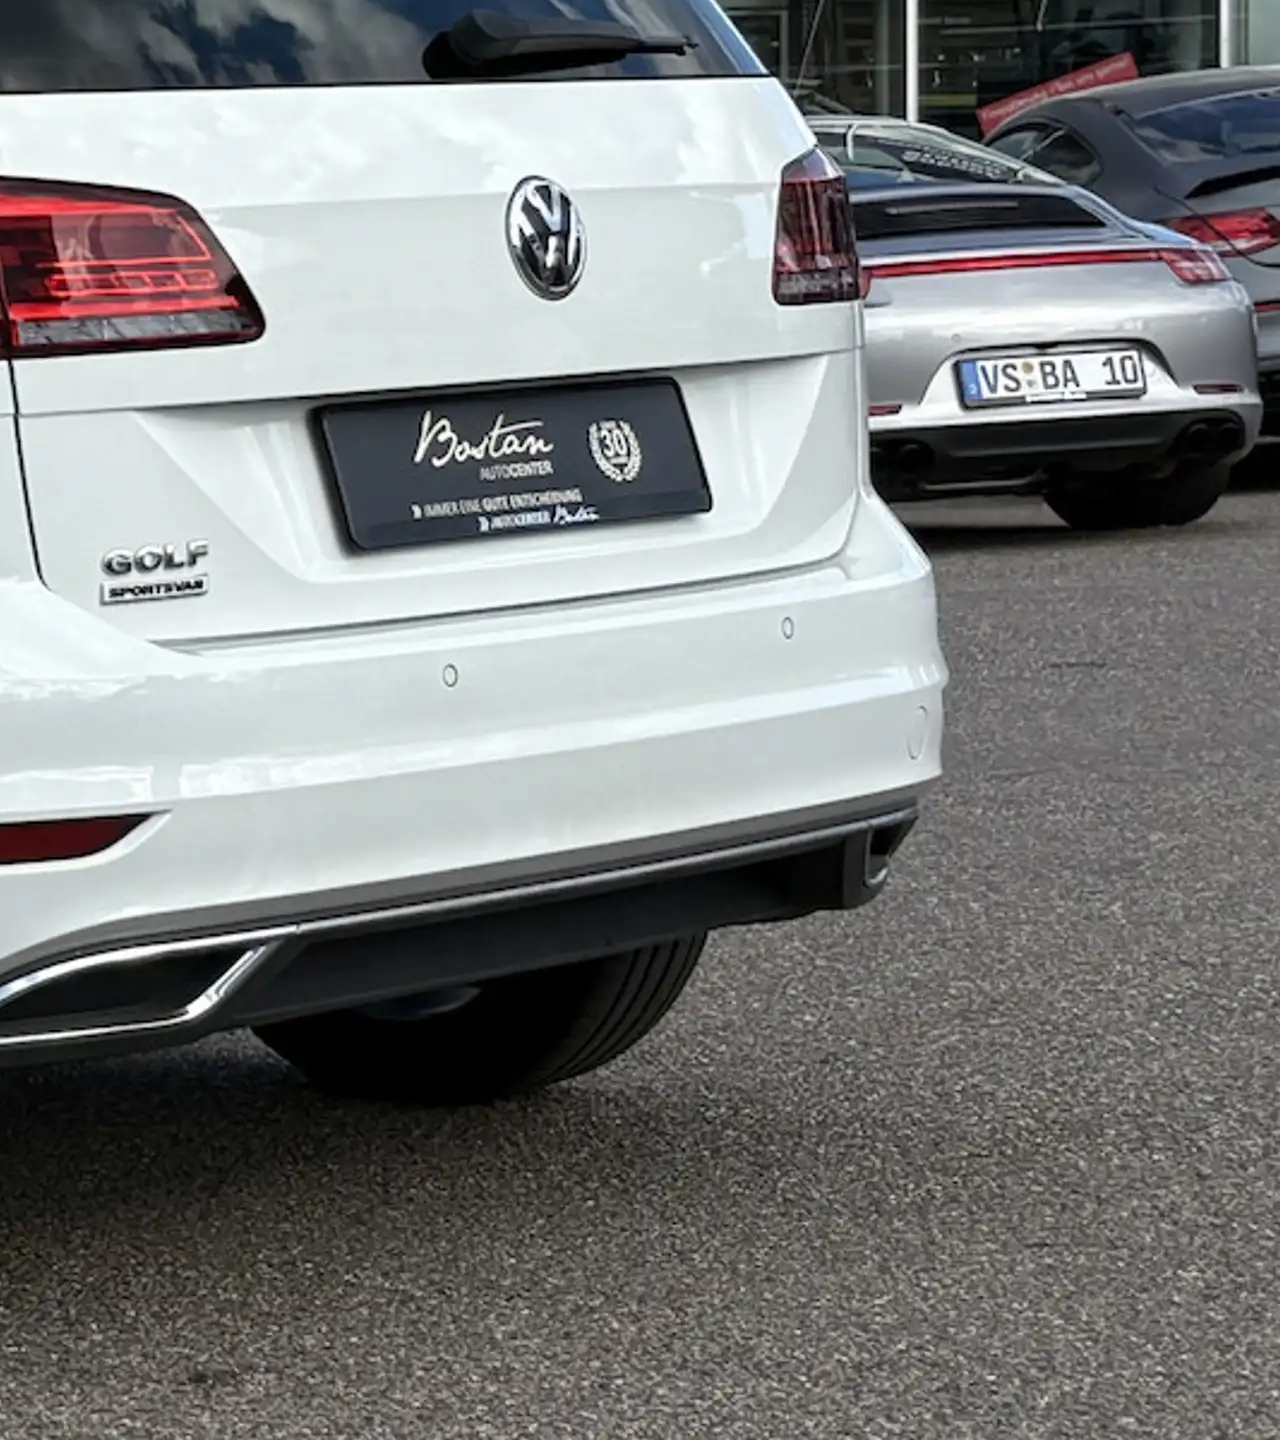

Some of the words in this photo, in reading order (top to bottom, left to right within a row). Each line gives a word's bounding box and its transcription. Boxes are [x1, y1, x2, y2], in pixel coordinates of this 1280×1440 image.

[980, 362, 1021, 394] VS
[1040, 359, 1080, 390] BA
[1102, 355, 1139, 385] 10
[413, 408, 554, 468] Bostan
[600, 428, 628, 457] 30
[479, 460, 554, 481] AUTOCENTER
[101, 539, 209, 576] GOLF
[107, 578, 205, 599] SPORTSVAN
